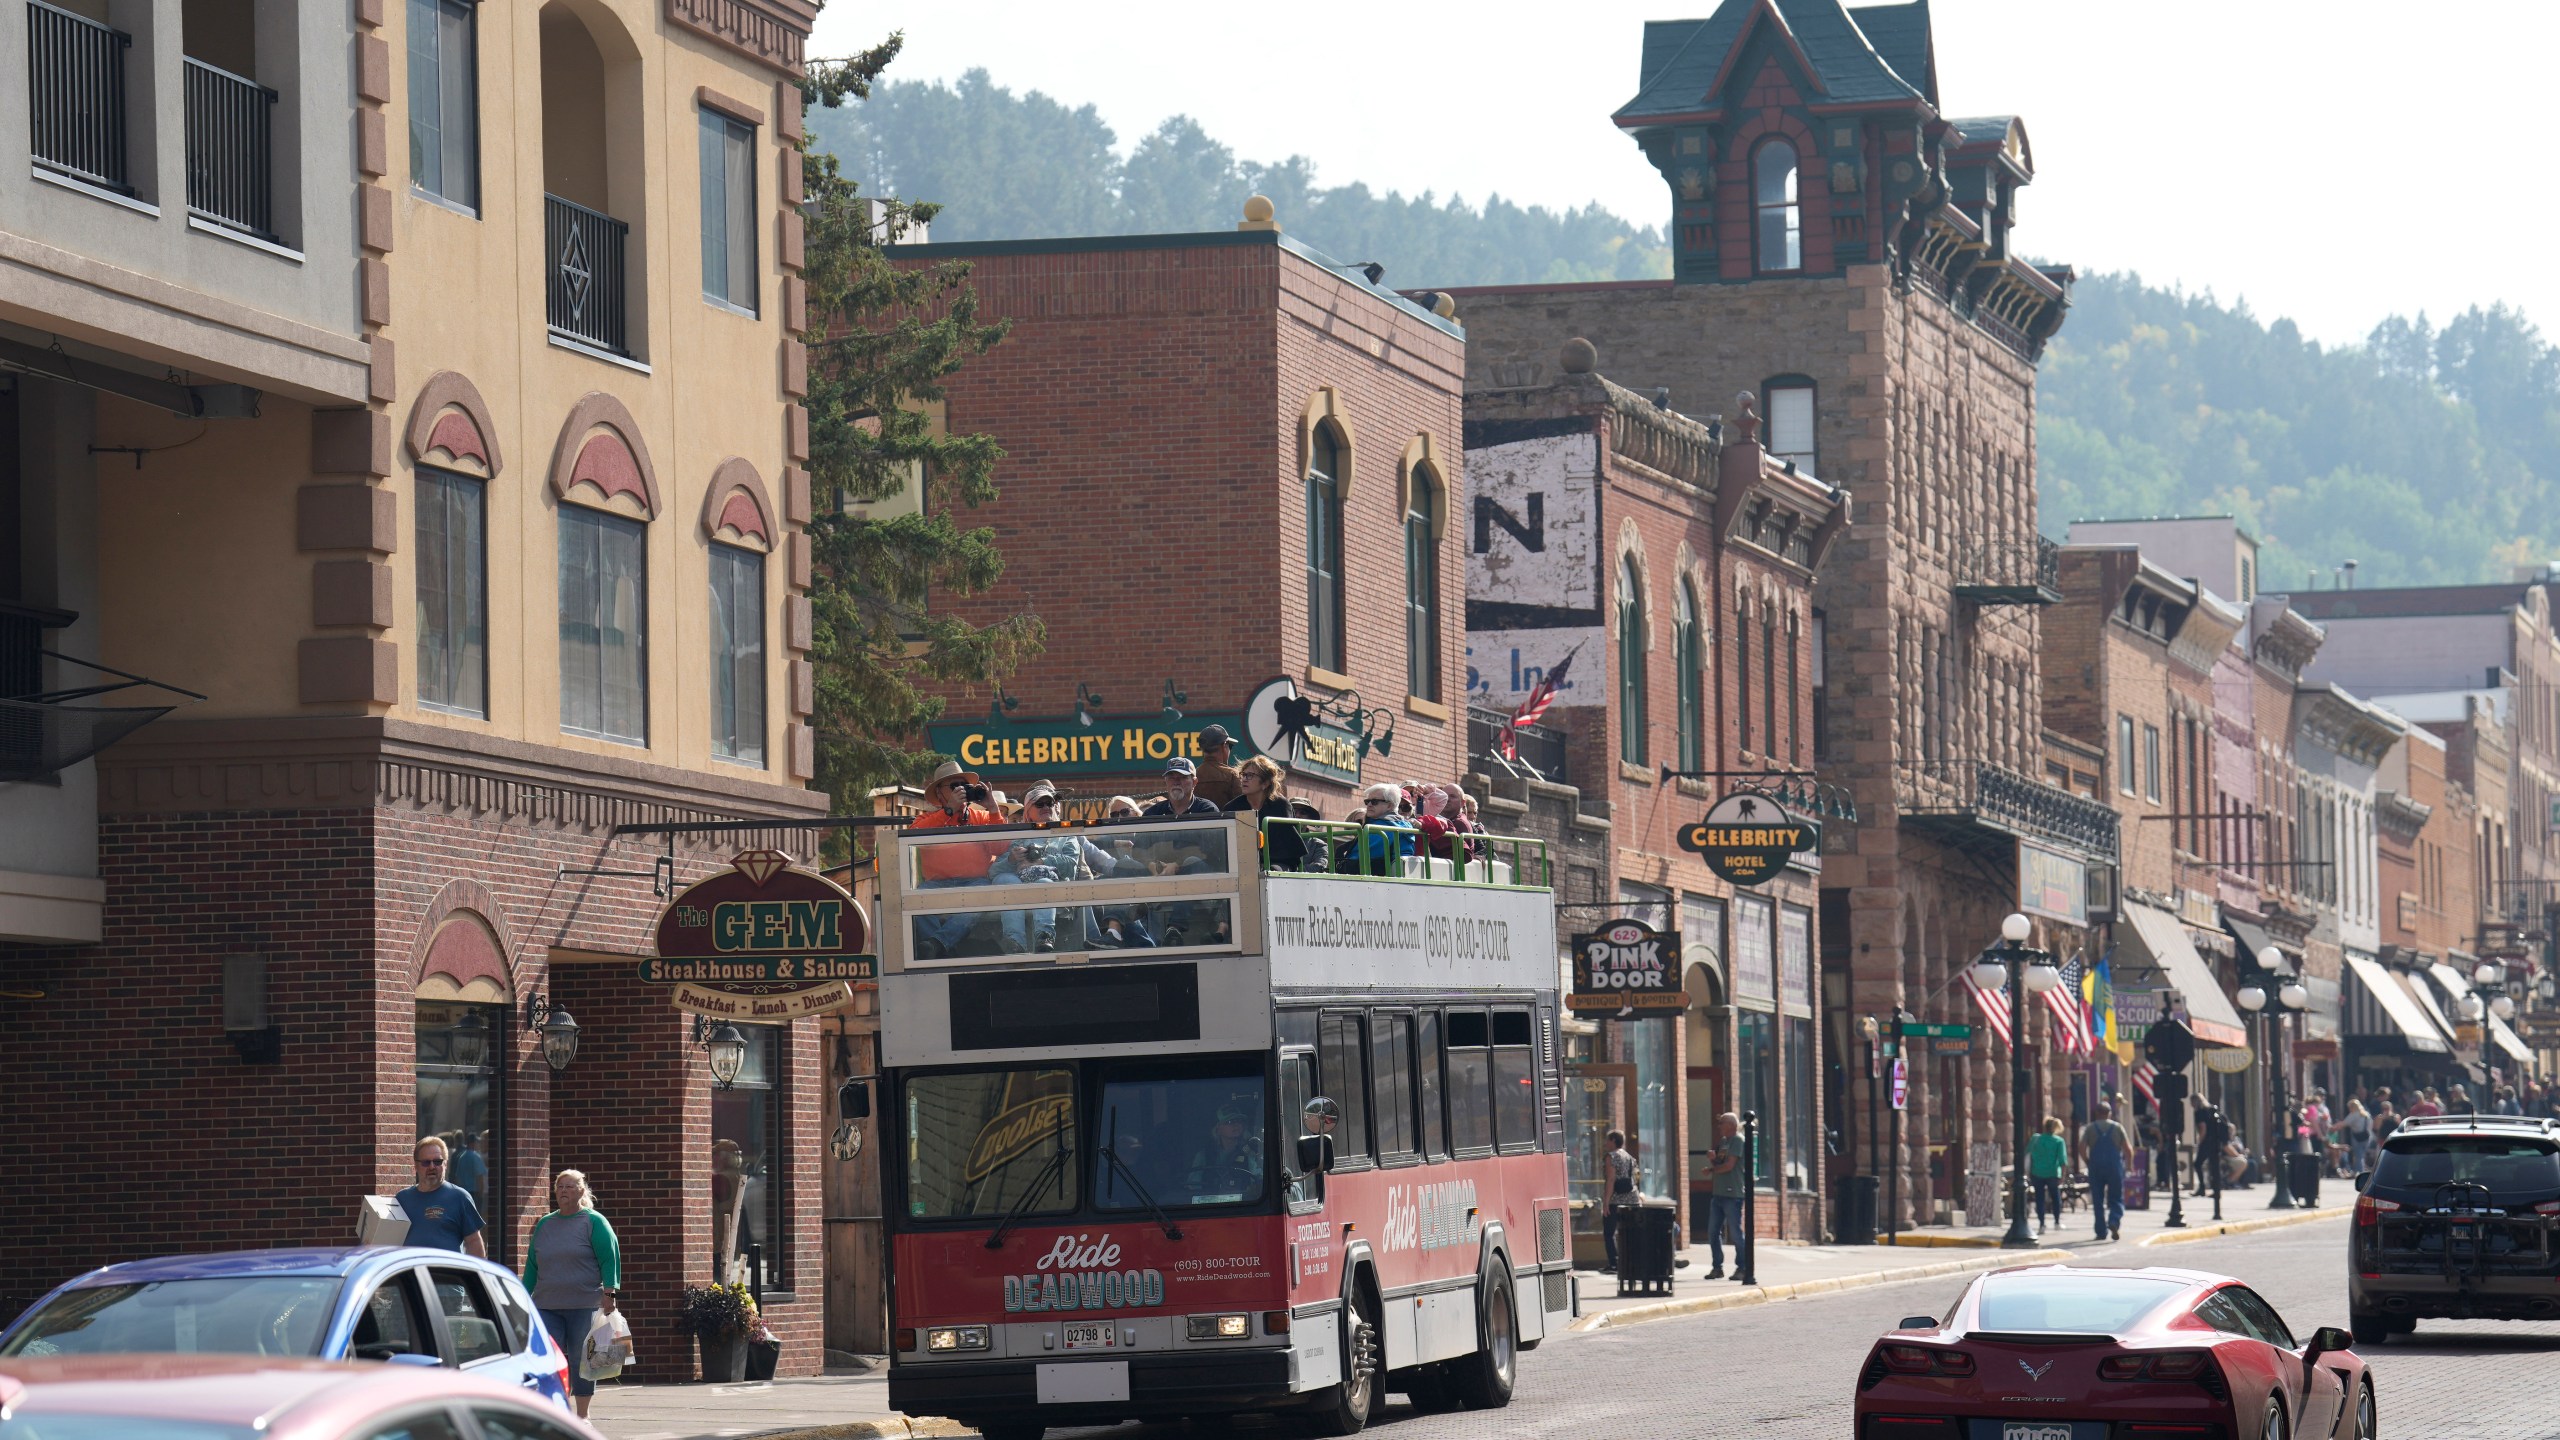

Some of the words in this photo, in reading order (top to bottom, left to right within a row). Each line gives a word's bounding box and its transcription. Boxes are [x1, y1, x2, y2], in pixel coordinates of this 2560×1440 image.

[1474, 492, 1544, 553] N
[1511, 648, 1573, 692] In.
[961, 734, 1113, 766] CELEBRITY
[1122, 728, 1204, 761] HOTE
[1691, 827, 1800, 847] CELEBRITY
[1724, 856, 1766, 867] HOTEL
[677, 906, 708, 927] The
[713, 900, 842, 952] GEM
[1275, 906, 1420, 950] www.RideDeadwood.com
[1424, 914, 1453, 968] (605)
[1455, 916, 1510, 961] 800-TOUR
[1614, 930, 1637, 941] 629
[1587, 941, 1664, 971] PINK
[650, 957, 766, 980] Steakhouse
[776, 958, 795, 978] &
[803, 957, 871, 978] Saloon
[1592, 971, 1663, 988] DOOR
[678, 989, 736, 1014] Breakfast
[752, 999, 788, 1015] Lunch
[802, 989, 843, 1011] Dinner
[1576, 995, 1618, 1005] BOUTIQUE
[1383, 1184, 1417, 1254] Ride
[1418, 1178, 1479, 1250] DEADWOOD
[1298, 1223, 1313, 1242] TOUR
[1313, 1221, 1331, 1239] TIMES
[1036, 1233, 1121, 1269] Ride
[1174, 1260, 1202, 1272] (605)
[1205, 1256, 1261, 1269] 800-TOUR
[1176, 1270, 1271, 1282] www.RideDeadwood.com
[1004, 1269, 1165, 1312] DEADWOOD
[1066, 1328, 1099, 1342] 02798
[1104, 1327, 1112, 1340] C
